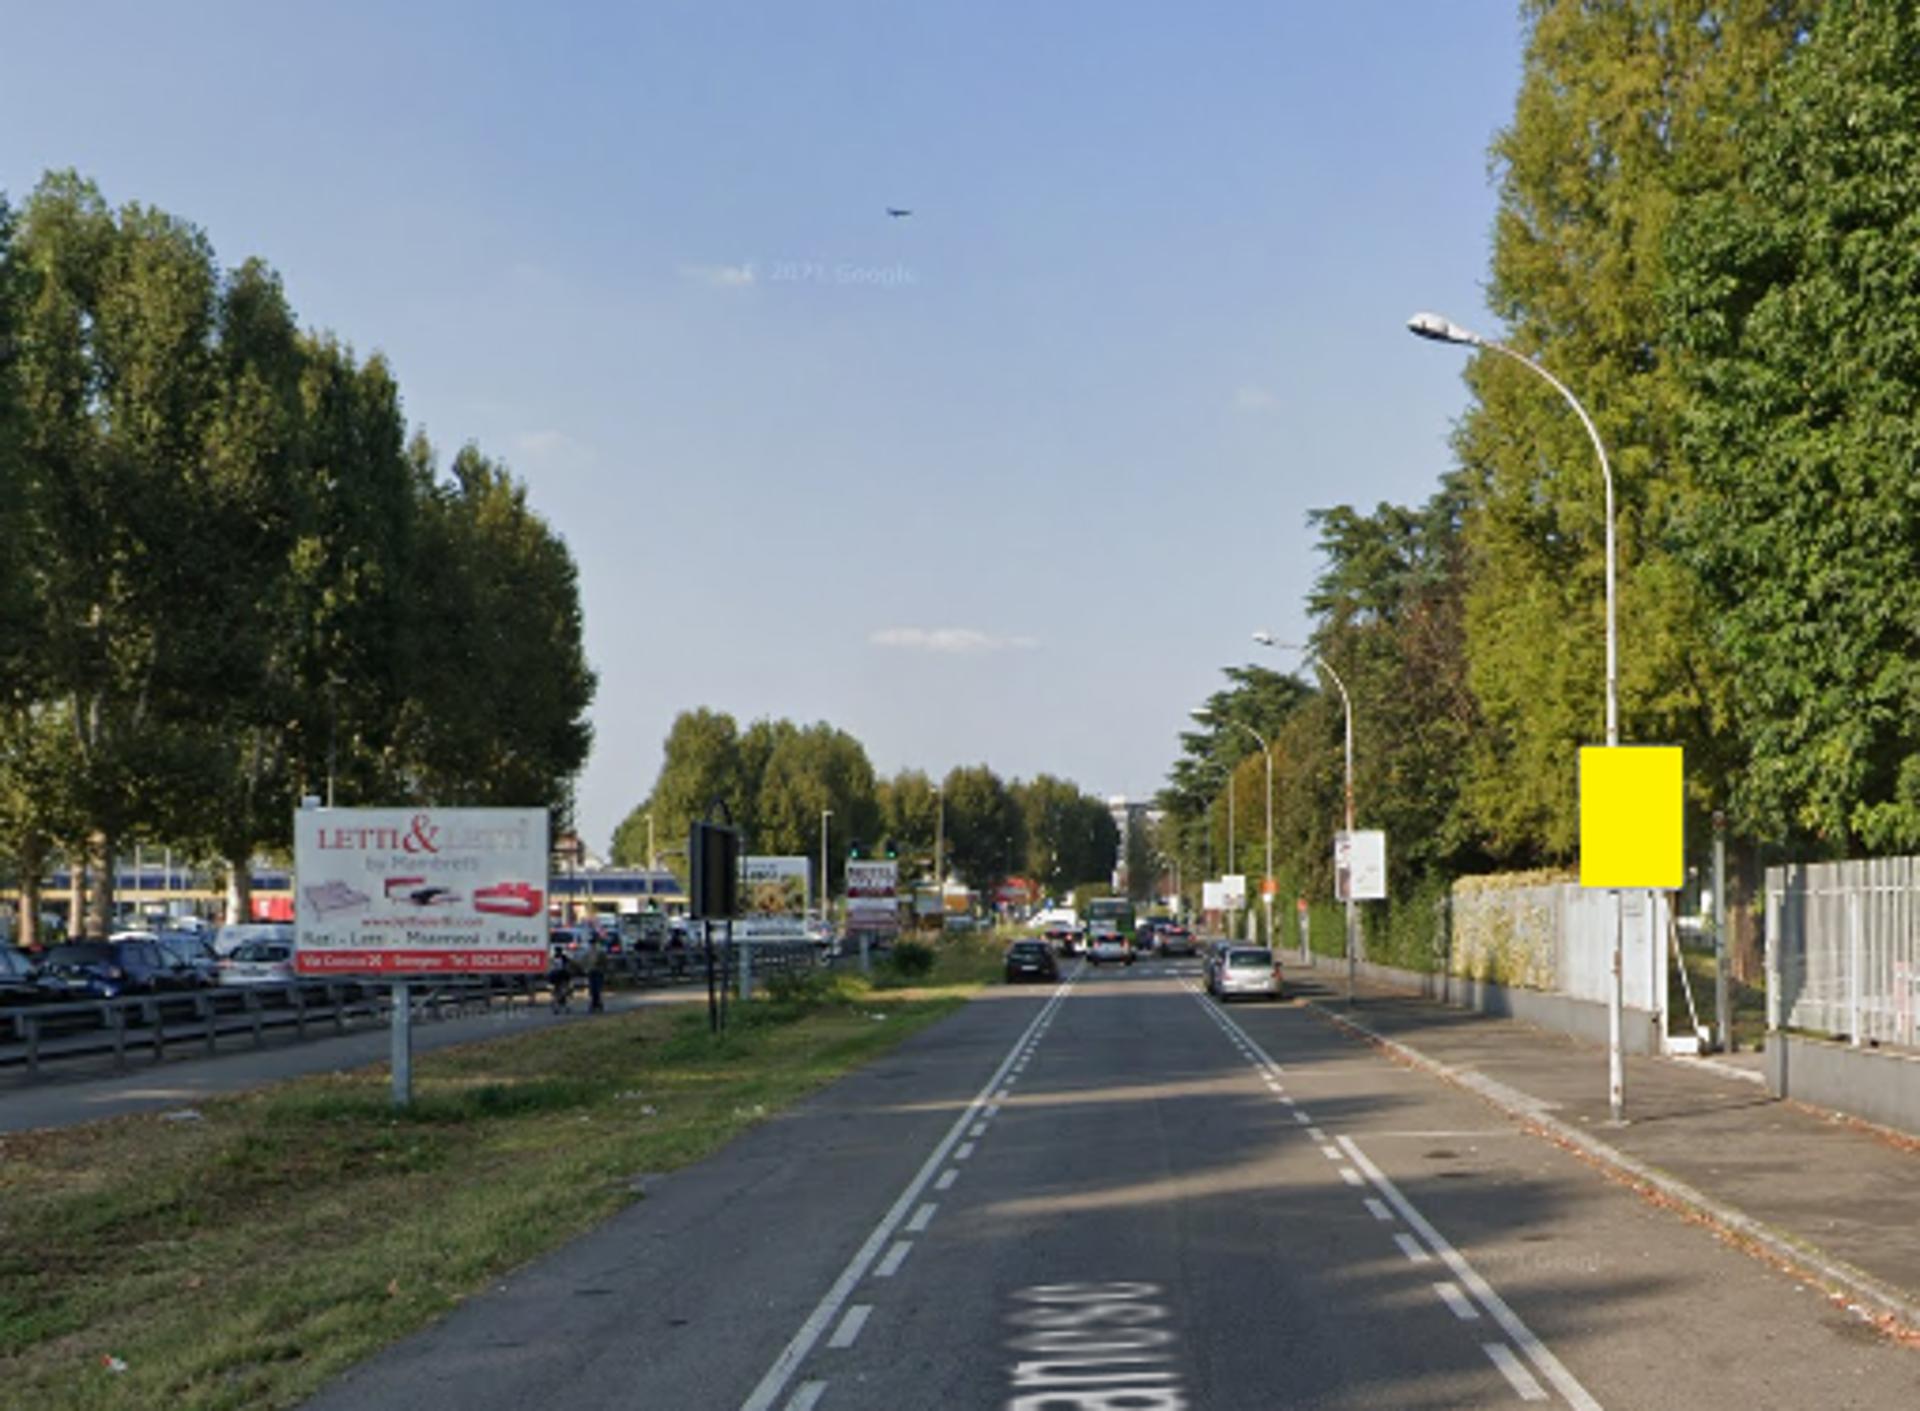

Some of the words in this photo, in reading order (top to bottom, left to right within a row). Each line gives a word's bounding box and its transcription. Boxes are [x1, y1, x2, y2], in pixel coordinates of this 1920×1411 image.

[317, 827, 398, 850] LETTI
[402, 814, 440, 853] &
[444, 827, 526, 851] LETTI
